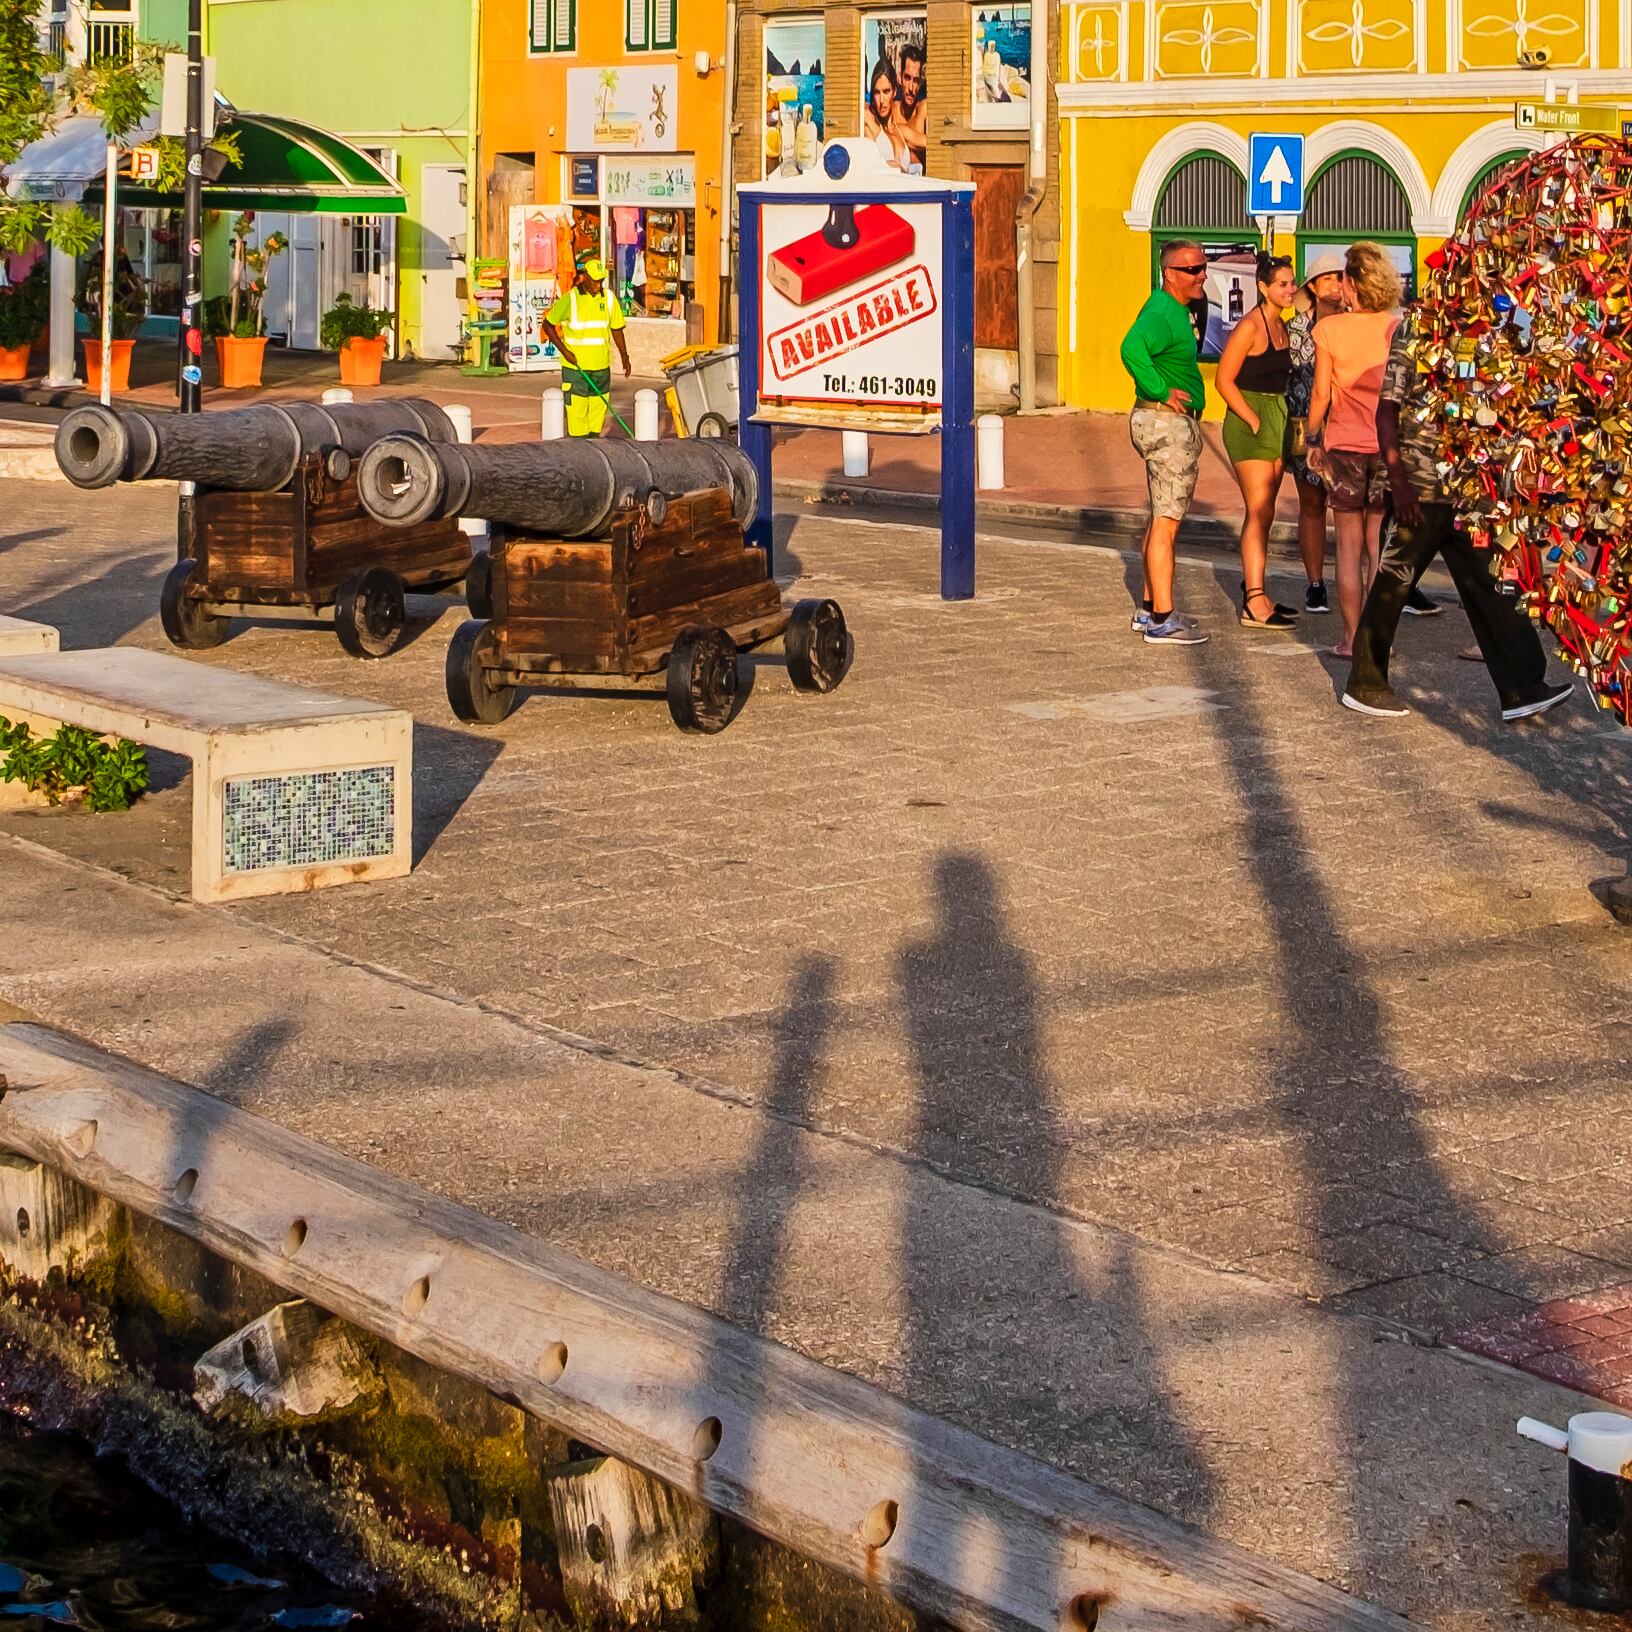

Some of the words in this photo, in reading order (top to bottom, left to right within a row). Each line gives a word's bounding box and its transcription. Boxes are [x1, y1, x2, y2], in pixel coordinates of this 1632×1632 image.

[1536, 109, 1559, 124] Water
[1560, 109, 1580, 125] Front
[780, 278, 924, 370] AVAILABLE
[823, 374, 856, 394] Tel.:
[858, 376, 937, 398] 461-3049
